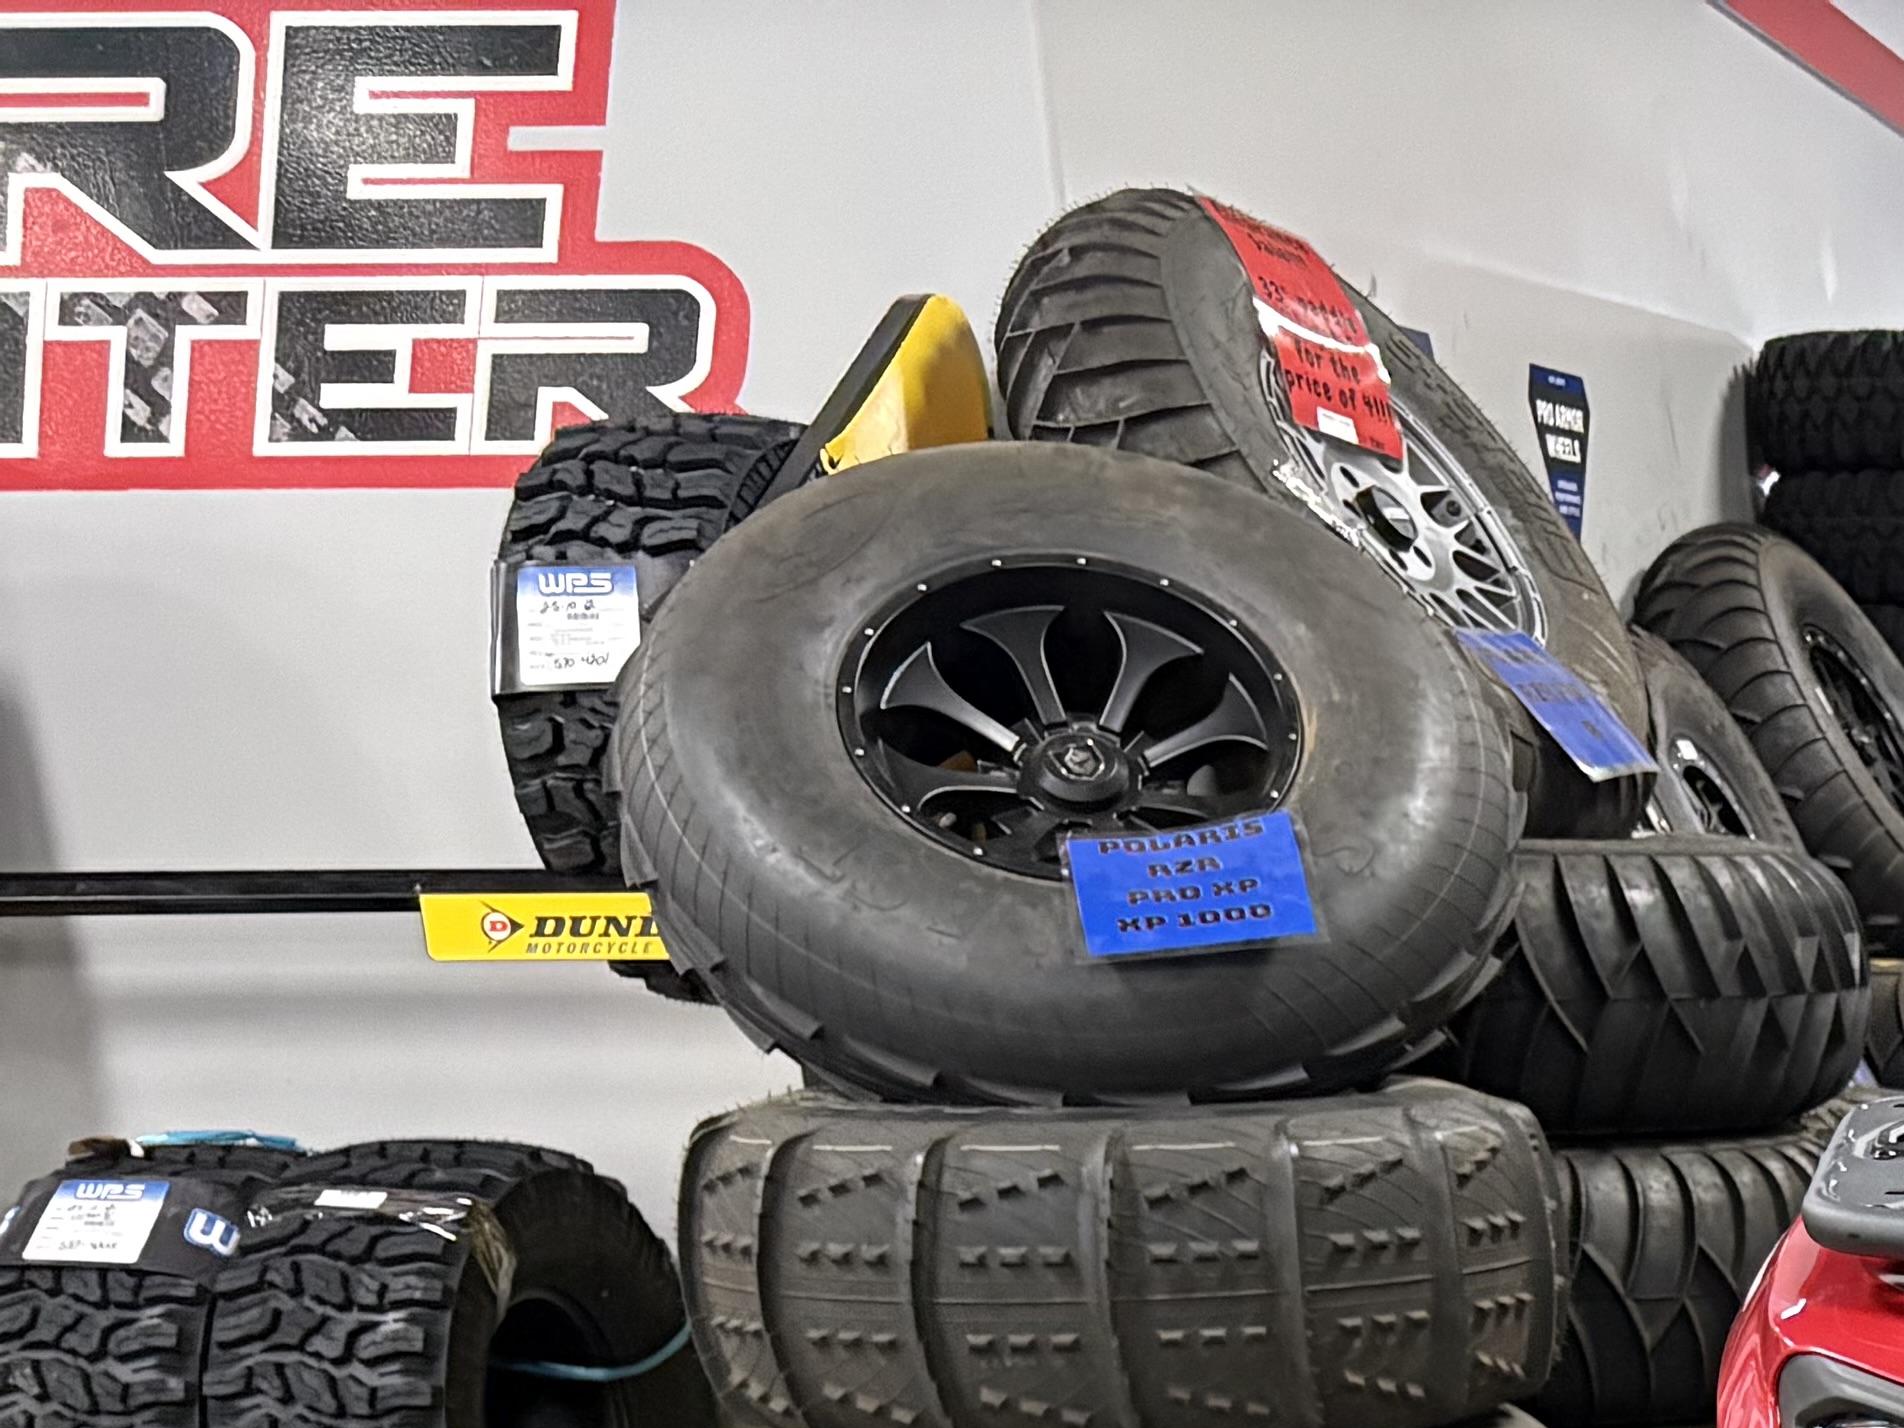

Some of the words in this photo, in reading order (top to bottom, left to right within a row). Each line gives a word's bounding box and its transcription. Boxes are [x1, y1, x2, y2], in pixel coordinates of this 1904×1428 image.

[0, 275, 717, 458] TER
[1329, 351, 1361, 384] the
[1285, 369, 1332, 403] price
[1338, 389, 1357, 409] of
[538, 572, 614, 595] WPS
[1098, 818, 1265, 856] POLARIS
[1127, 884, 1201, 907] PRO
[1212, 877, 1261, 898] XP
[1116, 914, 1167, 934] XP
[1177, 902, 1274, 928] 1000
[525, 942, 652, 954] MOTORCYCLE
[75, 1182, 145, 1201] WPS
